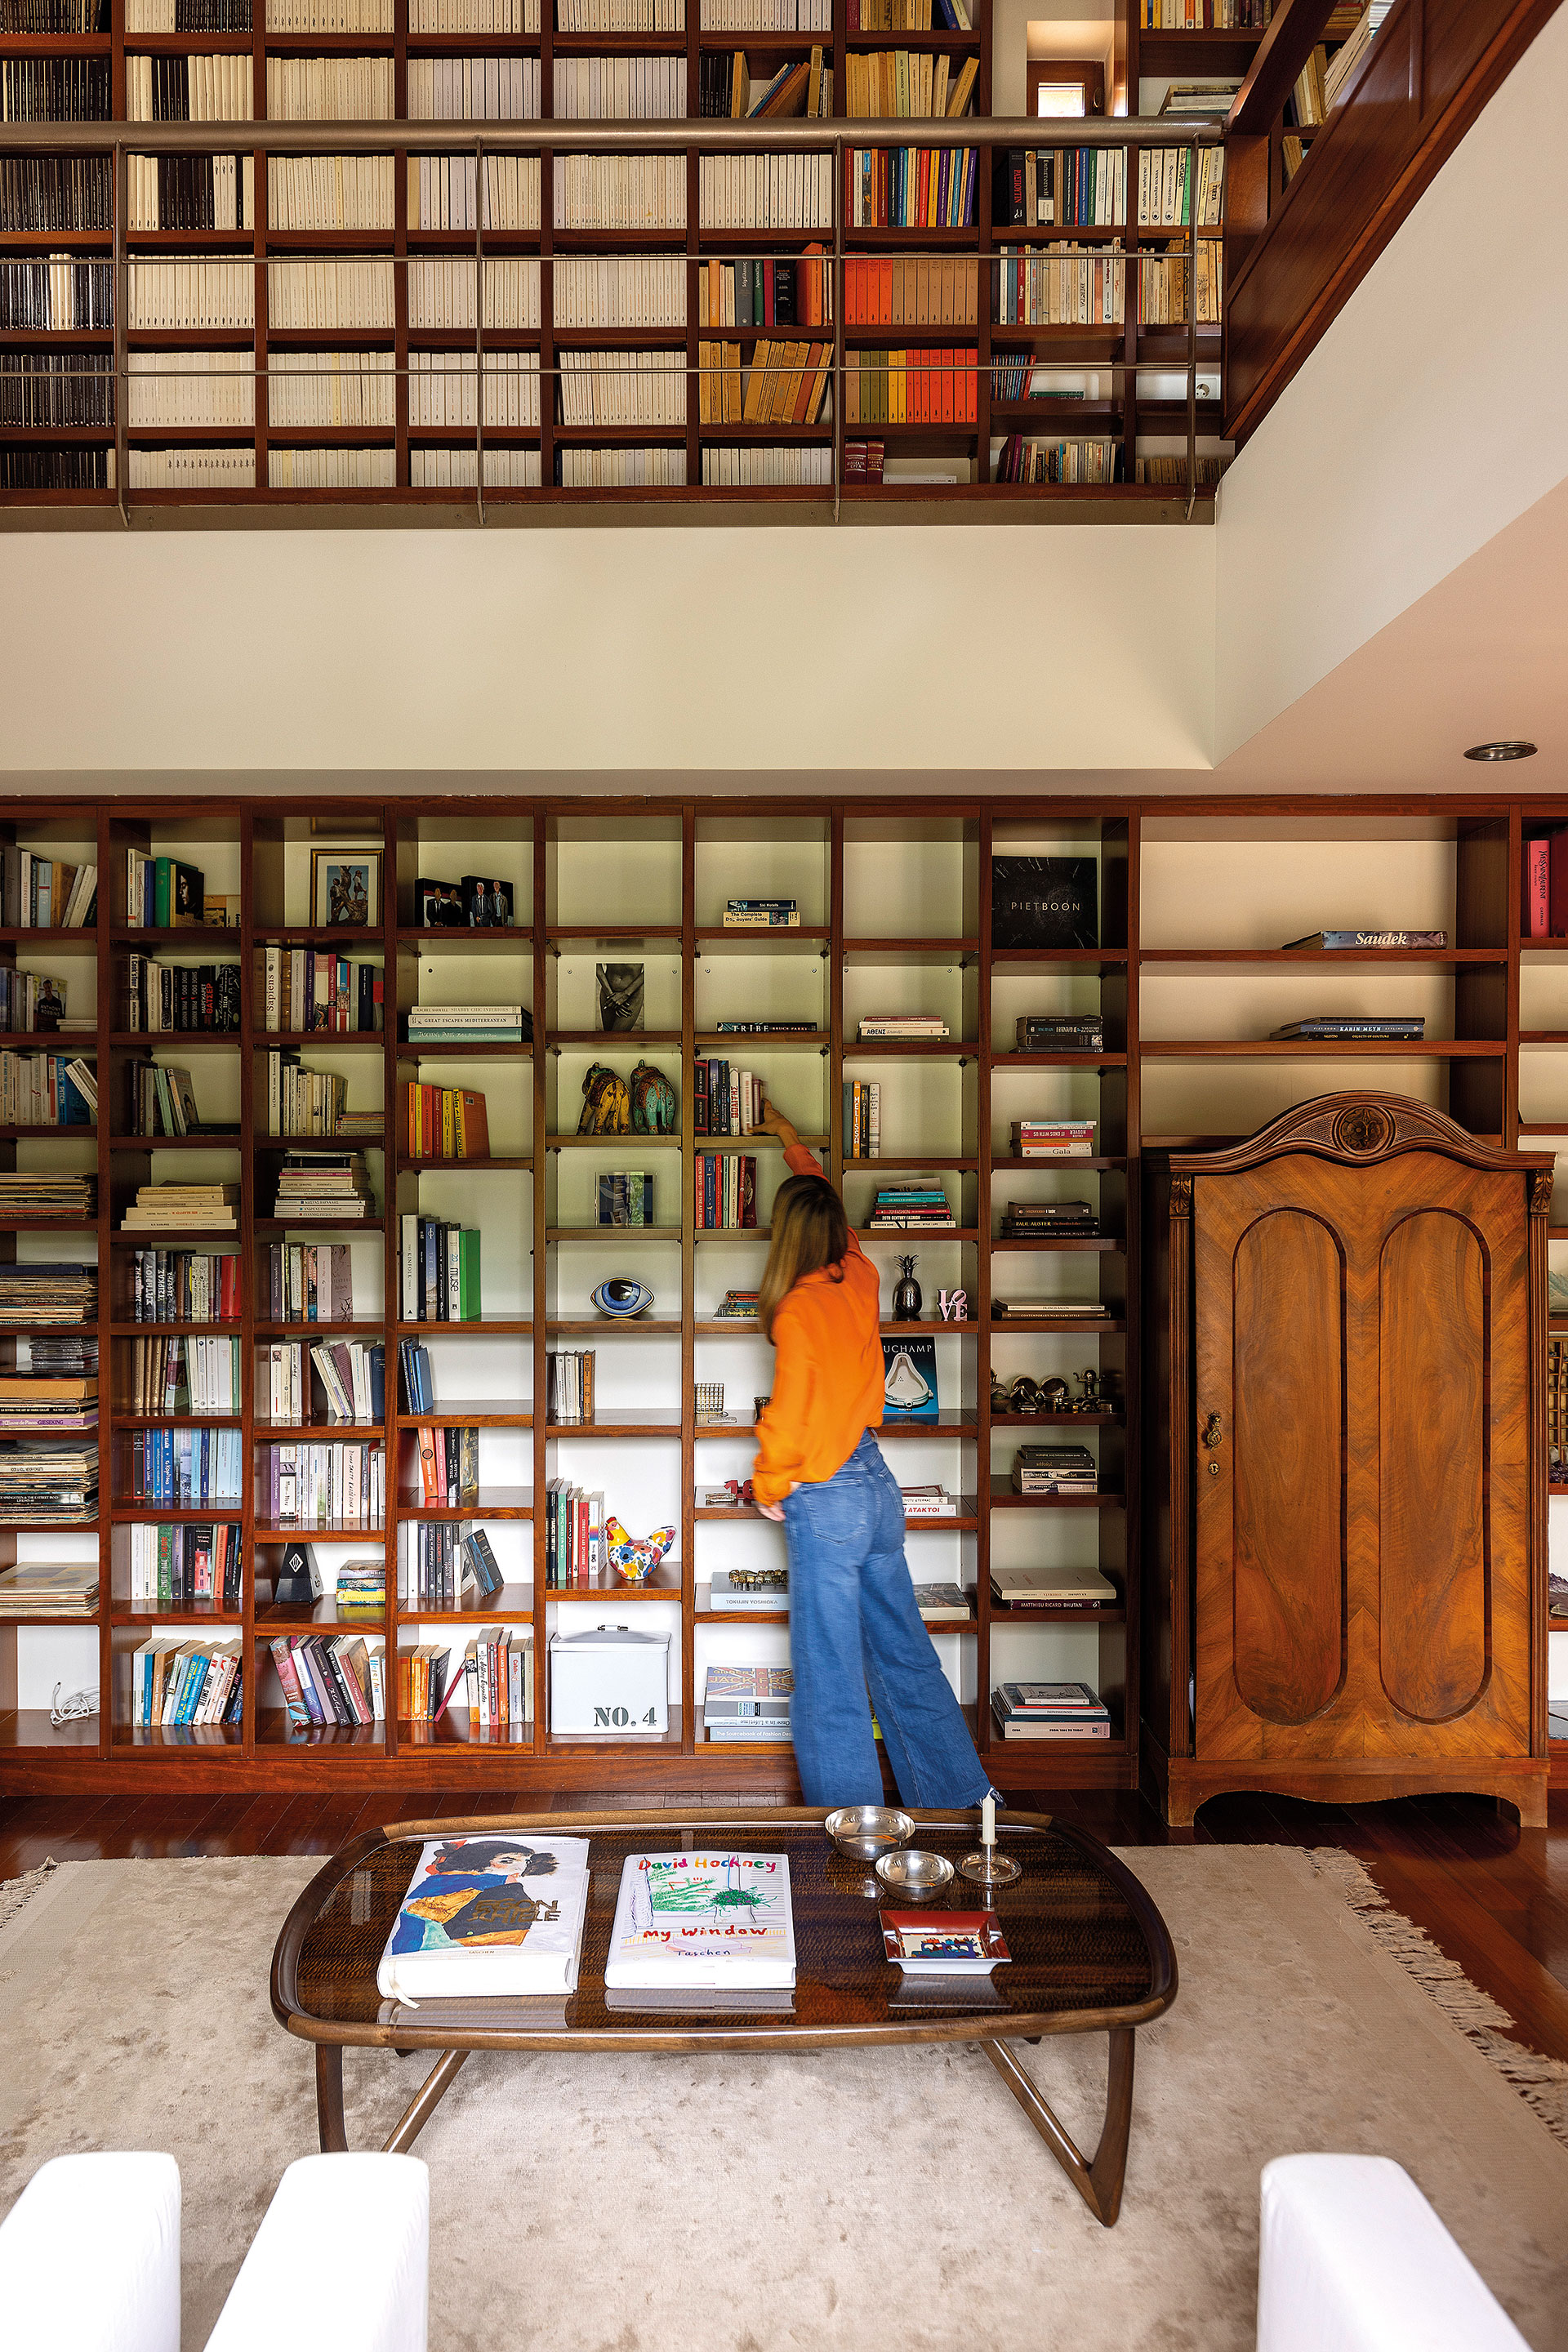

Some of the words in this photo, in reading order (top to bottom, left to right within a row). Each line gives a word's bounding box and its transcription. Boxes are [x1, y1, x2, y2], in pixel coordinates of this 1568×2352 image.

[1013, 169, 1022, 203] ΡΑΣΠΟΥΤΙΝ
[1010, 901, 1081, 912] PIETBOON
[1355, 932, 1408, 946] Saudek
[131, 960, 139, 976] Cook's
[131, 976, 139, 987] Tour
[206, 982, 214, 1014] ΘΑΤΣΕΡ
[266, 974, 276, 1012] Sapiens
[731, 1024, 770, 1032] TRIBE
[730, 1085, 739, 1119] ΠΟΛΙΤΗΣ
[451, 1254, 459, 1263] 20
[145, 1263, 154, 1306] ΣΩΤΗΡΙΟΥ
[449, 1267, 460, 1292] muse
[883, 1344, 933, 1354] UCHAMP
[210, 1659, 219, 1668] NW
[229, 1664, 237, 1677] TWICE
[479, 1660, 488, 1679] Jeffrey
[203, 1673, 214, 1690] ZADIE
[198, 1688, 210, 1707] SMITH
[593, 1707, 637, 1726] NO.
[642, 1707, 657, 1726] 4
[637, 1857, 688, 1871] David
[694, 1855, 777, 1873] Hockney
[473, 1898, 559, 1914] EGON
[681, 1925, 768, 1937] Window
